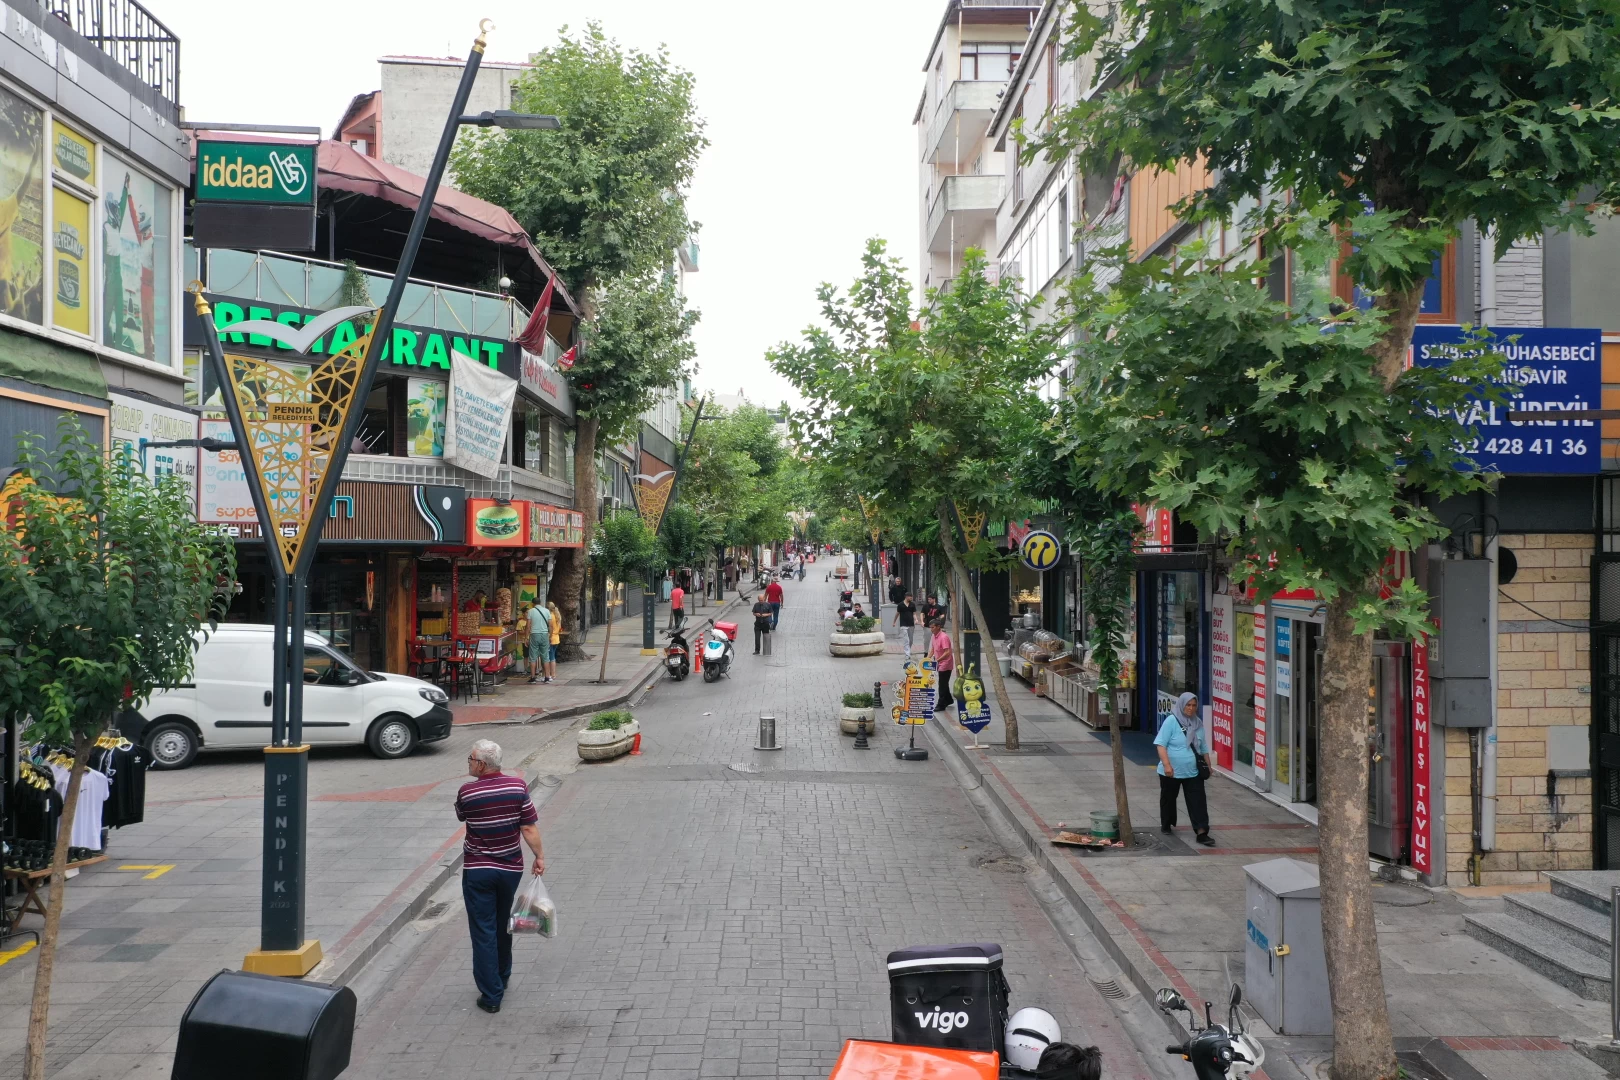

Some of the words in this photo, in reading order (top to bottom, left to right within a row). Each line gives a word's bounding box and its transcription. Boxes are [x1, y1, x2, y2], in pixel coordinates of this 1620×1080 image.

[203, 155, 273, 189] iddaa
[1492, 341, 1596, 361] MUHASEBECİ
[274, 404, 313, 415] PENDİK
[1449, 437, 1480, 455] 32
[1484, 437, 1523, 455] 428
[1529, 438, 1552, 455] 41
[1562, 438, 1587, 456] 36
[216, 506, 256, 520] süpe
[1213, 619, 1223, 629] BUT
[273, 773, 288, 893] PENDİK
[1415, 782, 1427, 866] TAVUK
[914, 1005, 969, 1034] vigo
